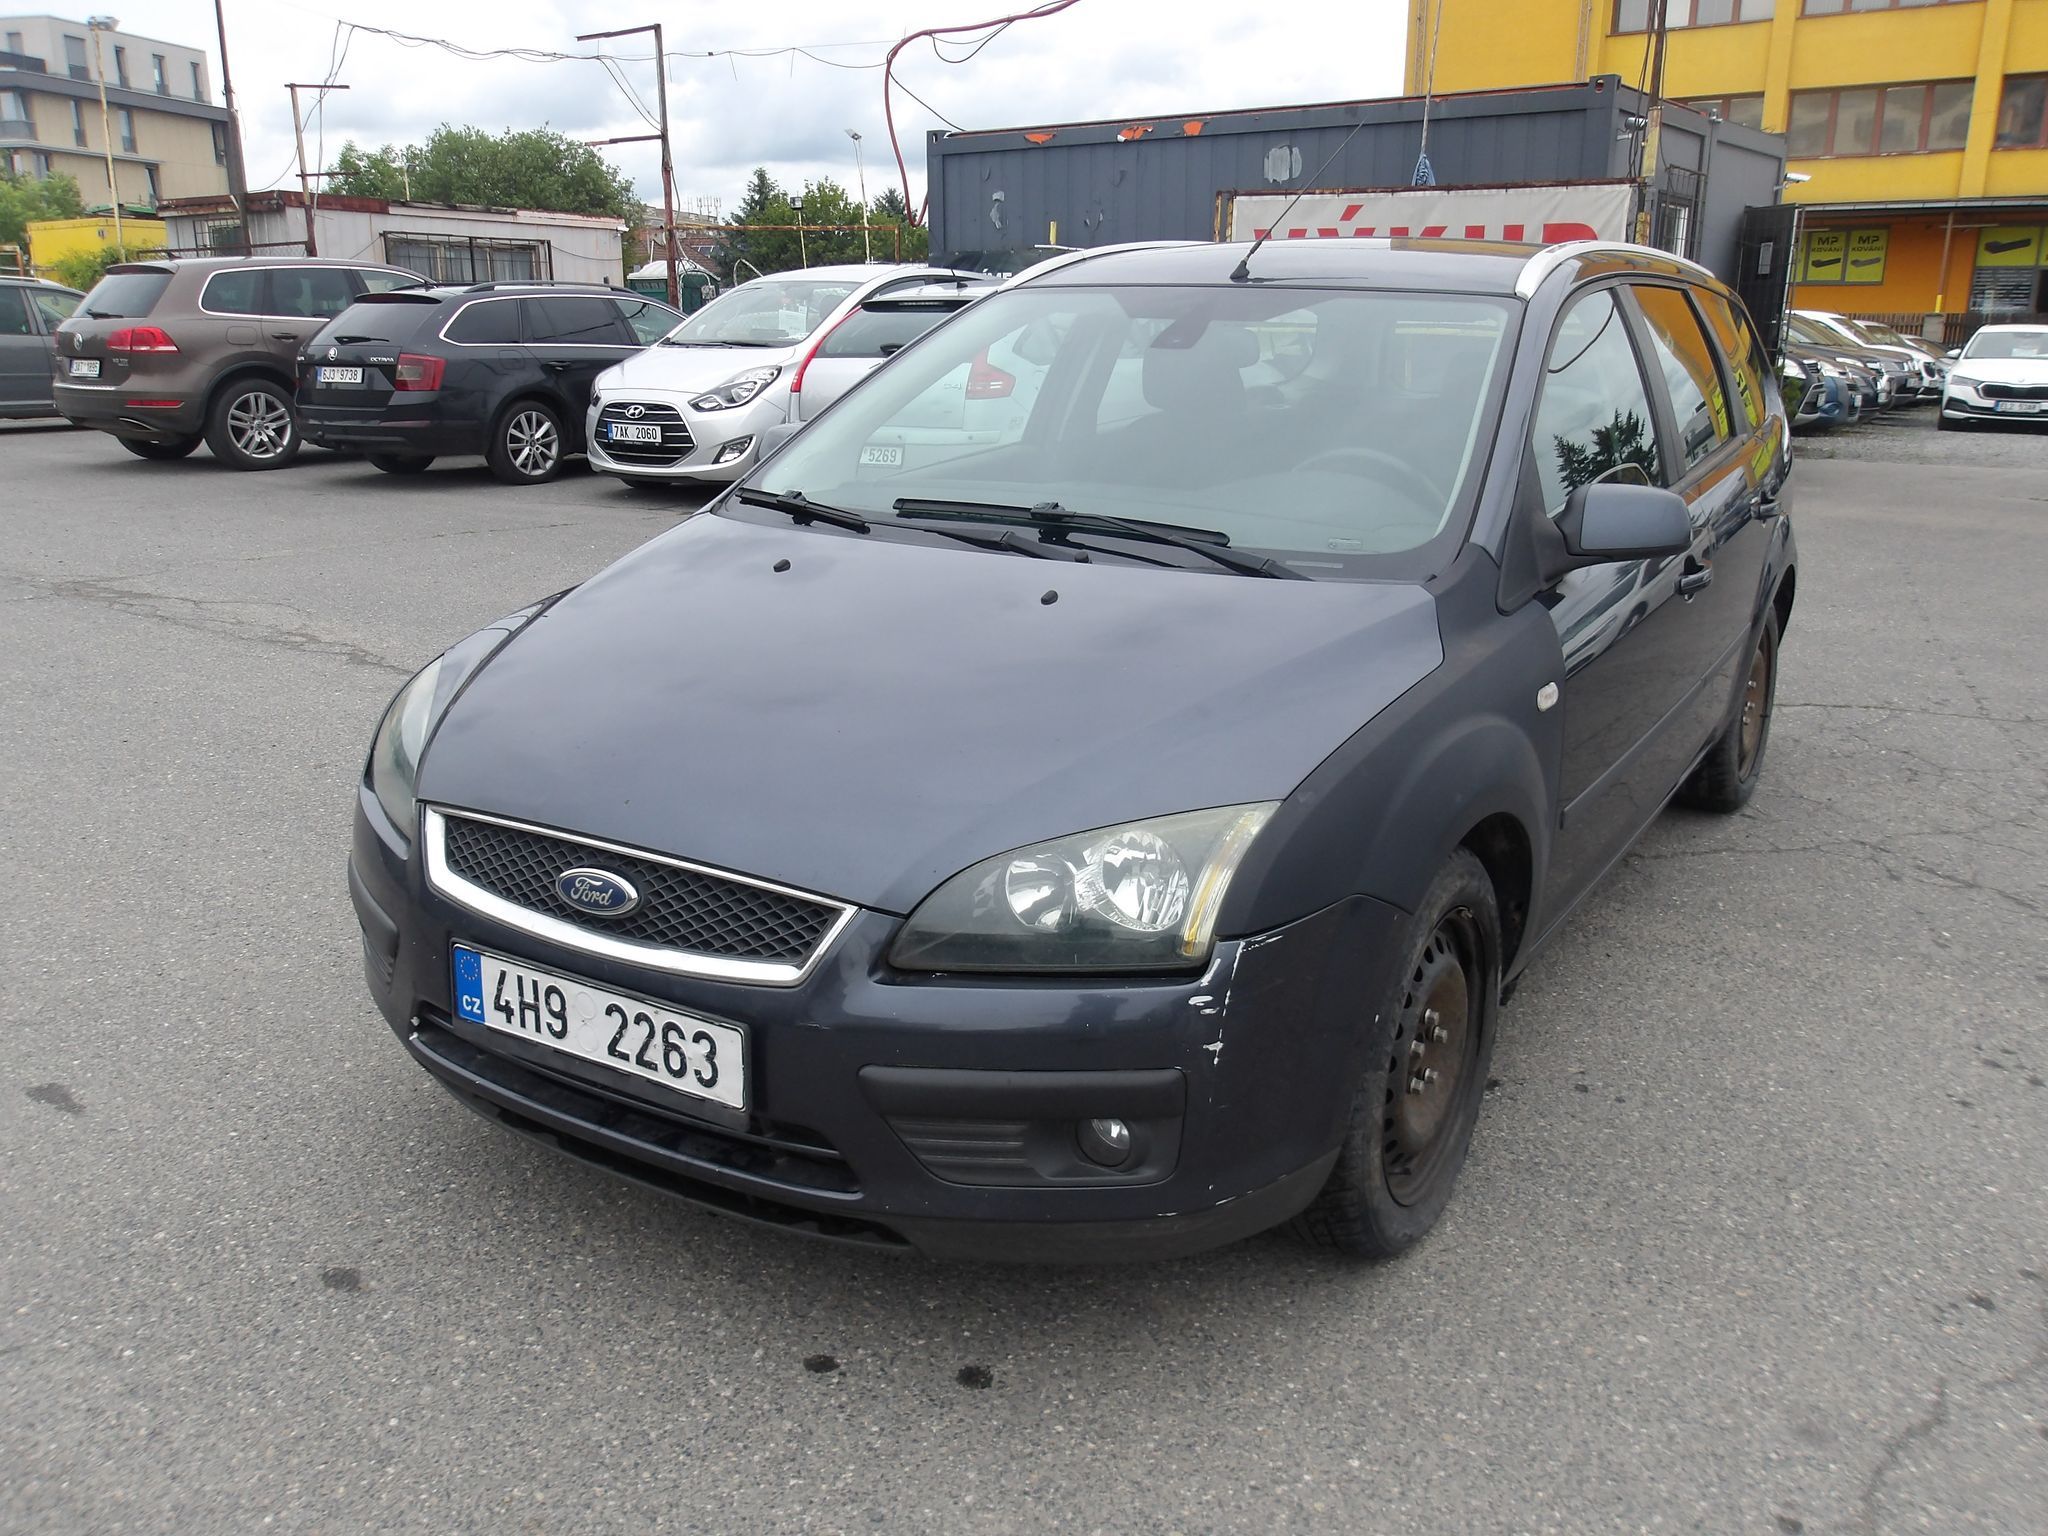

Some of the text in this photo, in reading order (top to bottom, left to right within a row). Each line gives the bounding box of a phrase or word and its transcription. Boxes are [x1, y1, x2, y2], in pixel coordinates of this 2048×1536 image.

[1818, 236, 1839, 245] MP
[1858, 235, 1880, 244] MP
[340, 369, 358, 381] 9738
[614, 425, 657, 440] 7AK 2060
[868, 448, 897, 463] 5269
[570, 876, 614, 906] Ford
[462, 994, 482, 1014] CZ
[493, 968, 719, 1089] 4H9 2263
